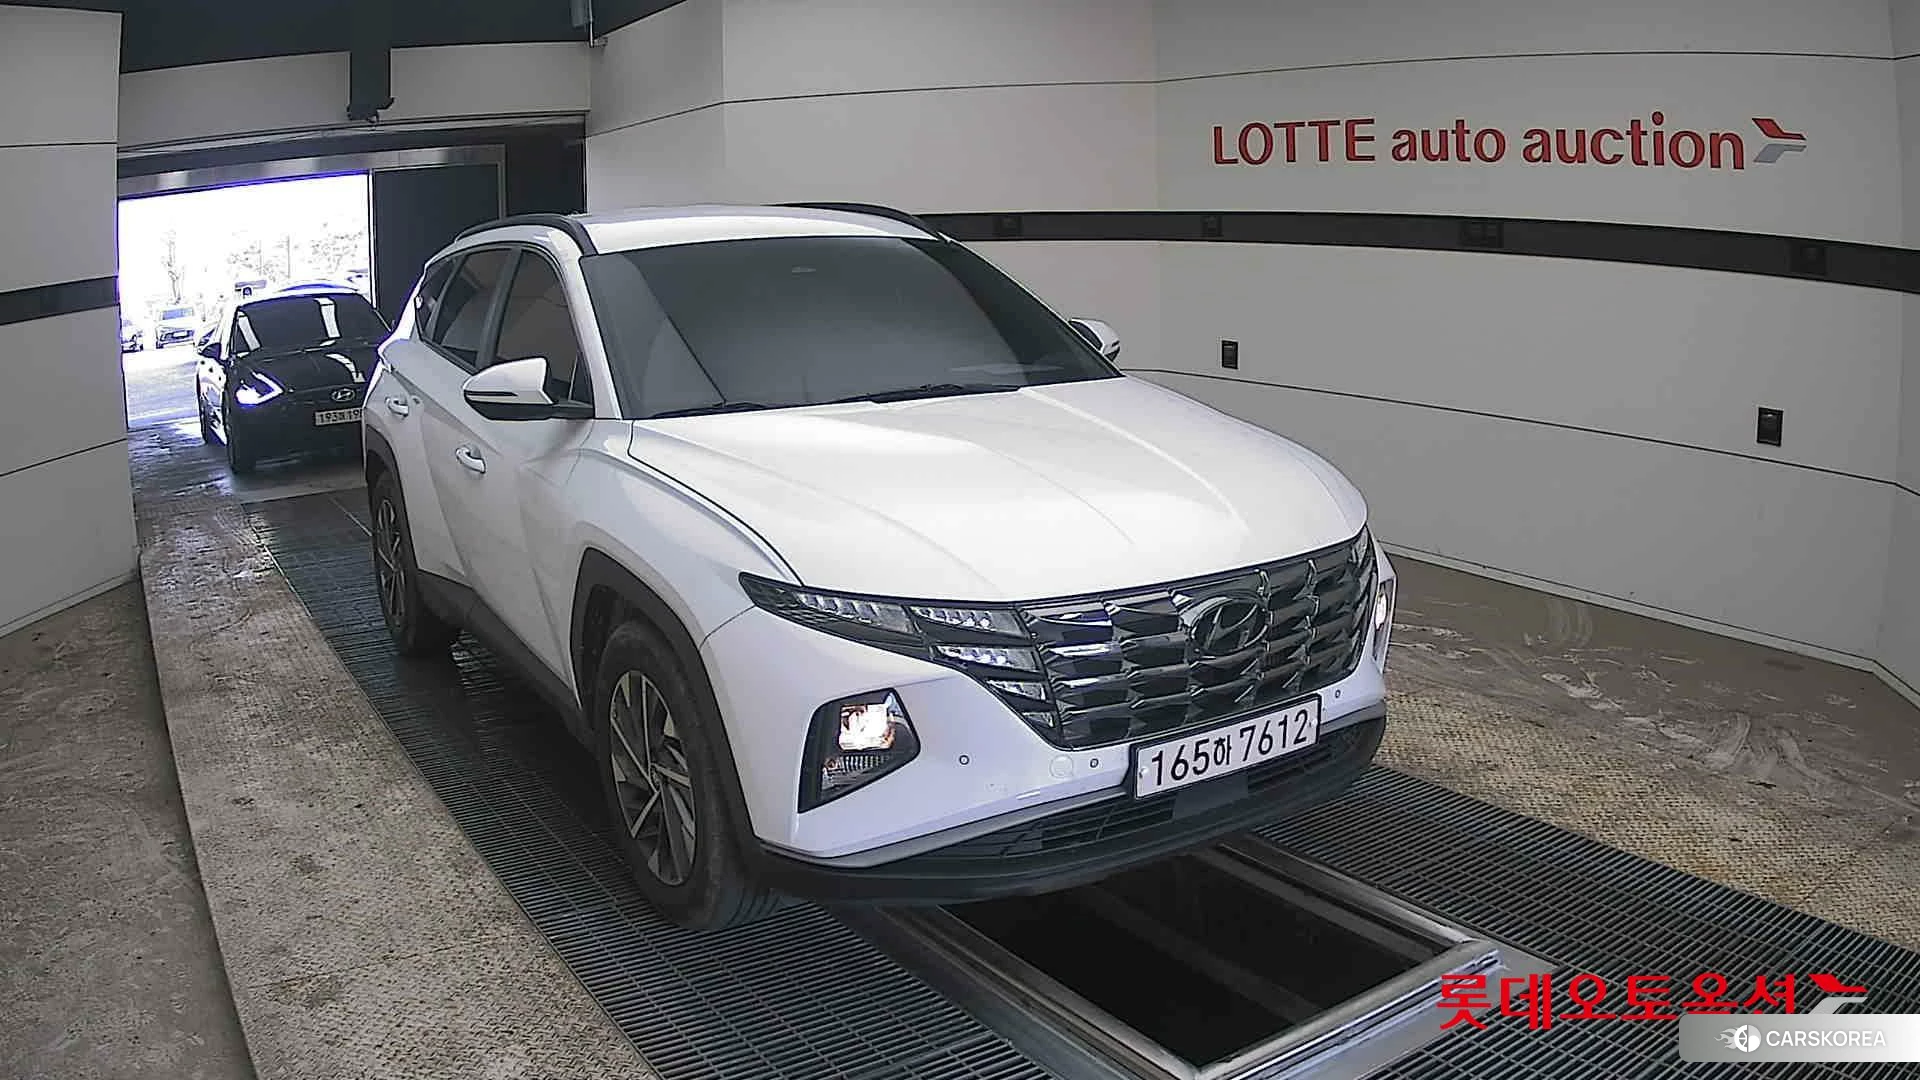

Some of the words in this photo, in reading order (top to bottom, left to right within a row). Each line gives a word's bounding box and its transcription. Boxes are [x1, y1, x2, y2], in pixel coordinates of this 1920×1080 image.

[1213, 118, 1376, 165] LOTTE
[1392, 119, 1506, 163] auto
[1522, 111, 1745, 170] auction
[1151, 734, 1233, 786] 165하
[1239, 709, 1309, 762] 7612
